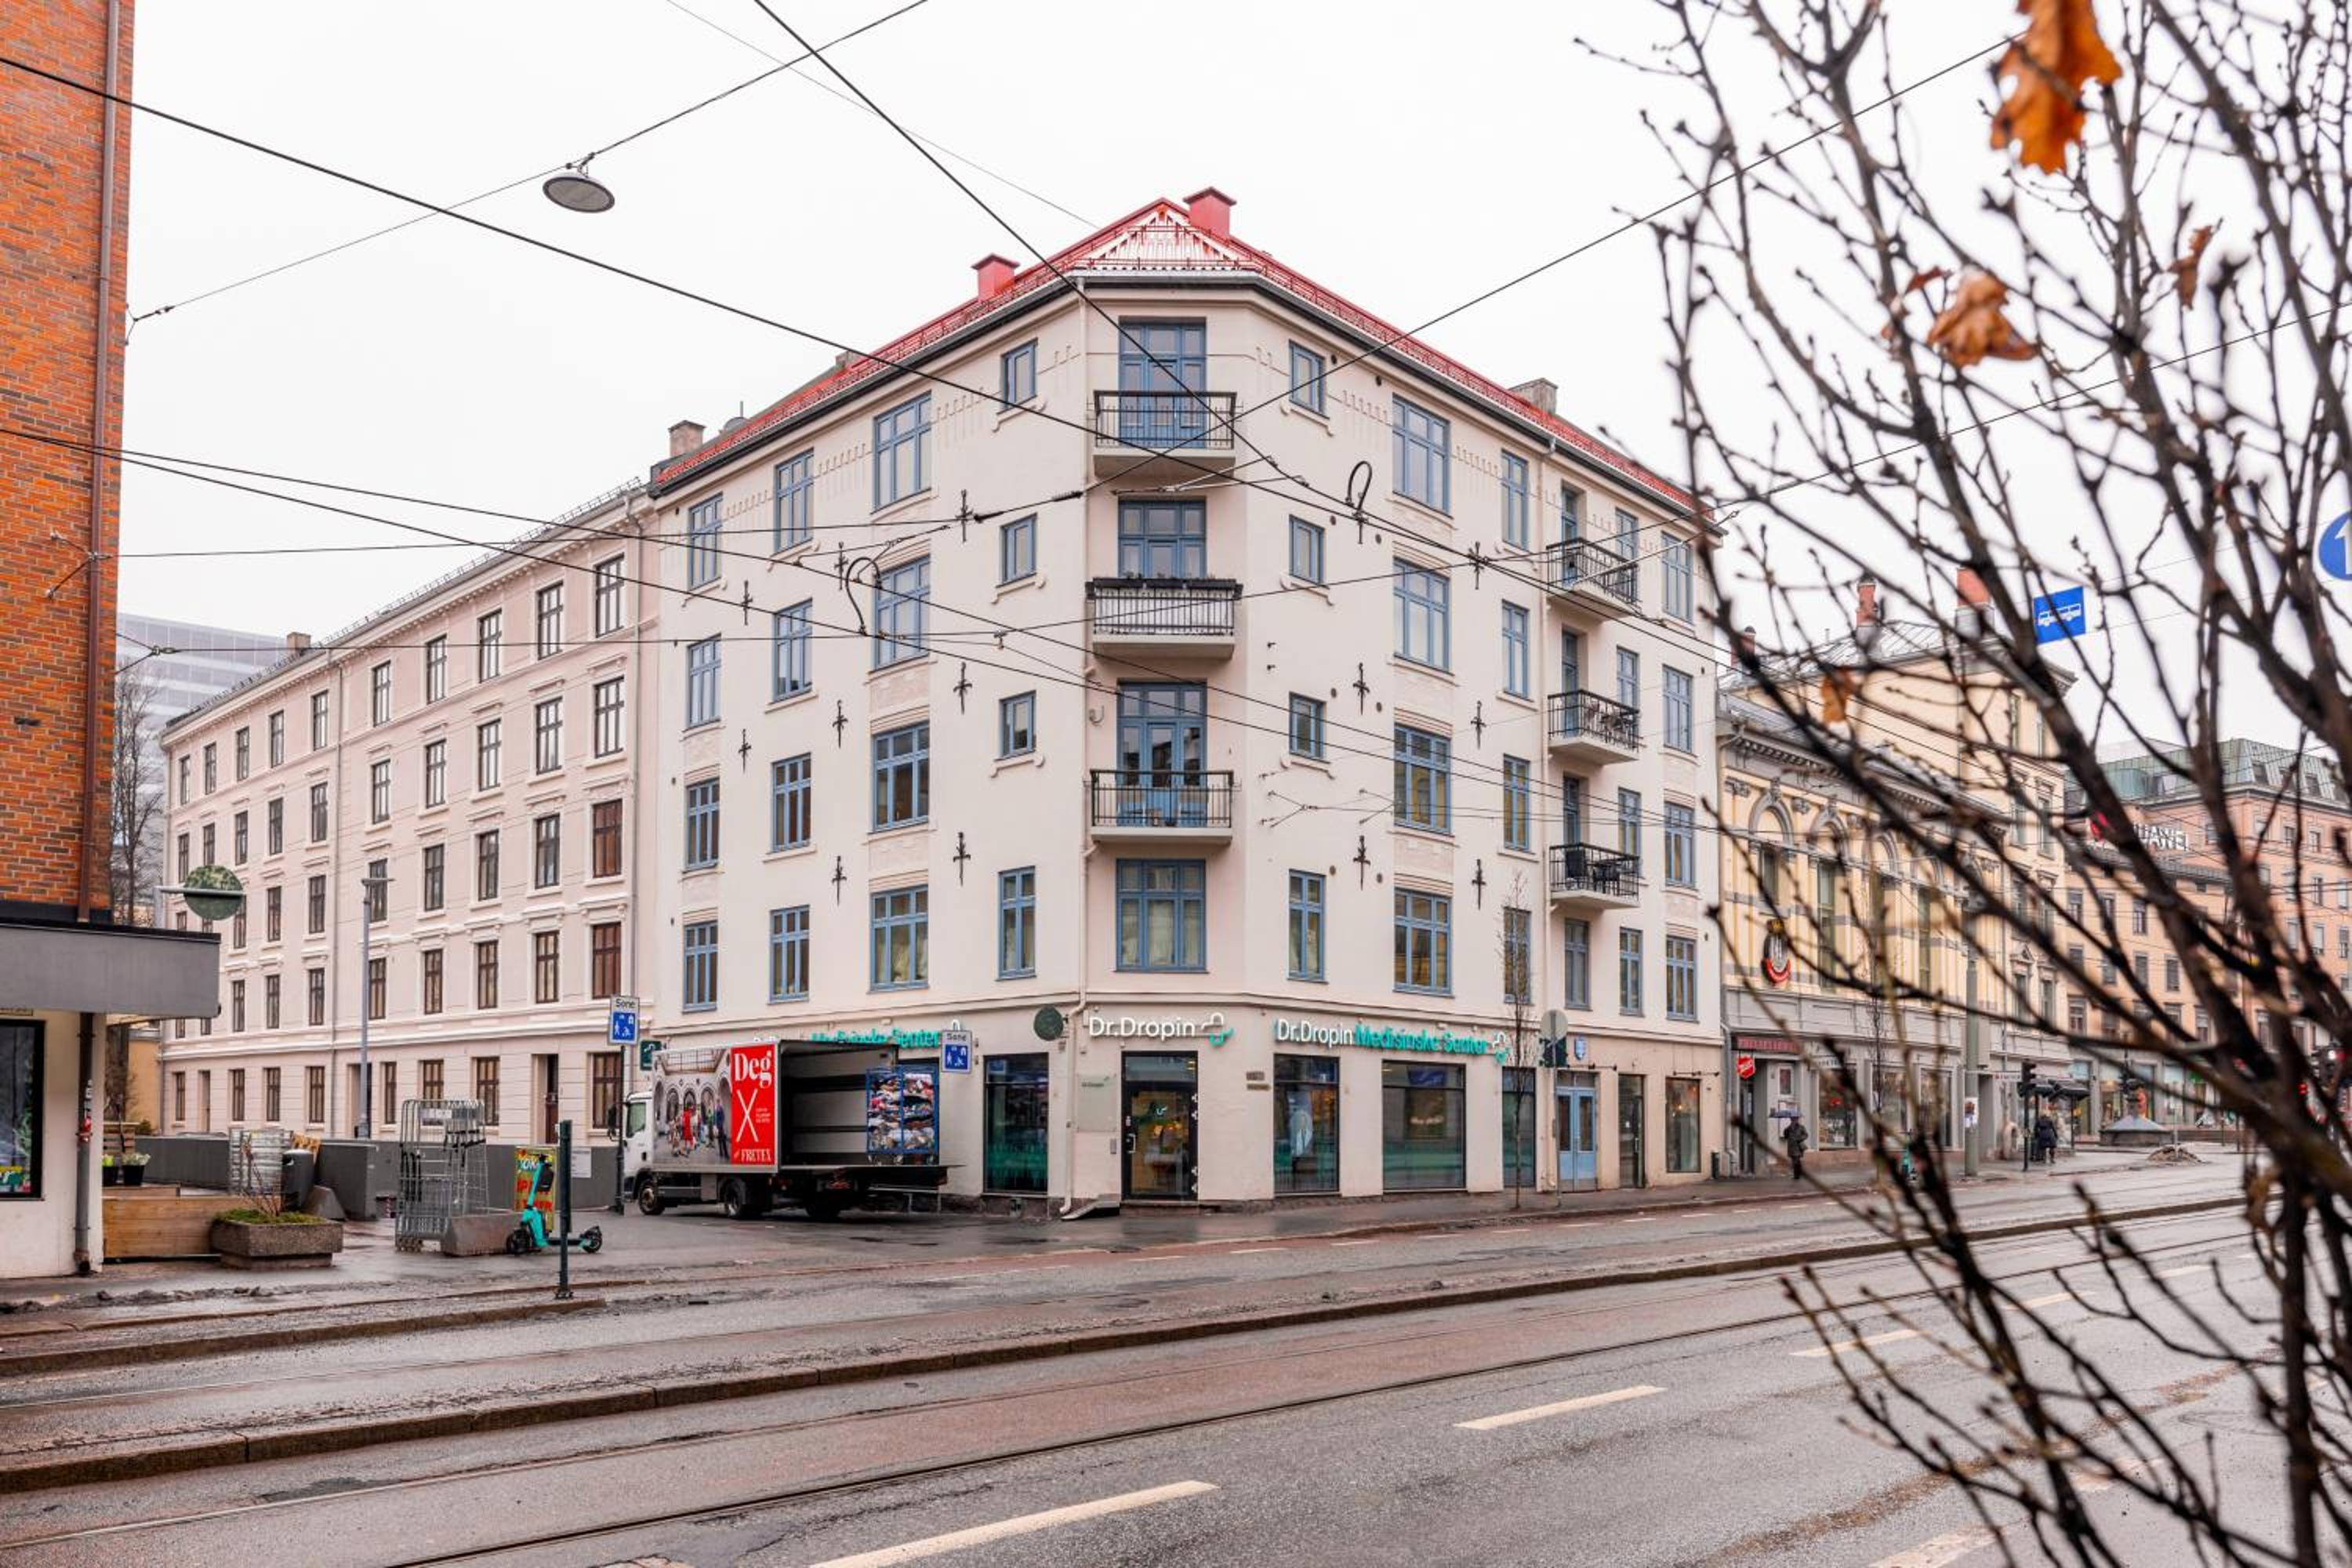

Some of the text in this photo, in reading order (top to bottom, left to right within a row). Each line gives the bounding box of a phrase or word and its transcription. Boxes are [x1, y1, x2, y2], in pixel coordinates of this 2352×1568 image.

[1090, 1017, 1195, 1041] Dr.Dropin
[1276, 1019, 1488, 1054] Dr.Dropin Medisinske Senter
[735, 1051, 772, 1089] Deg
